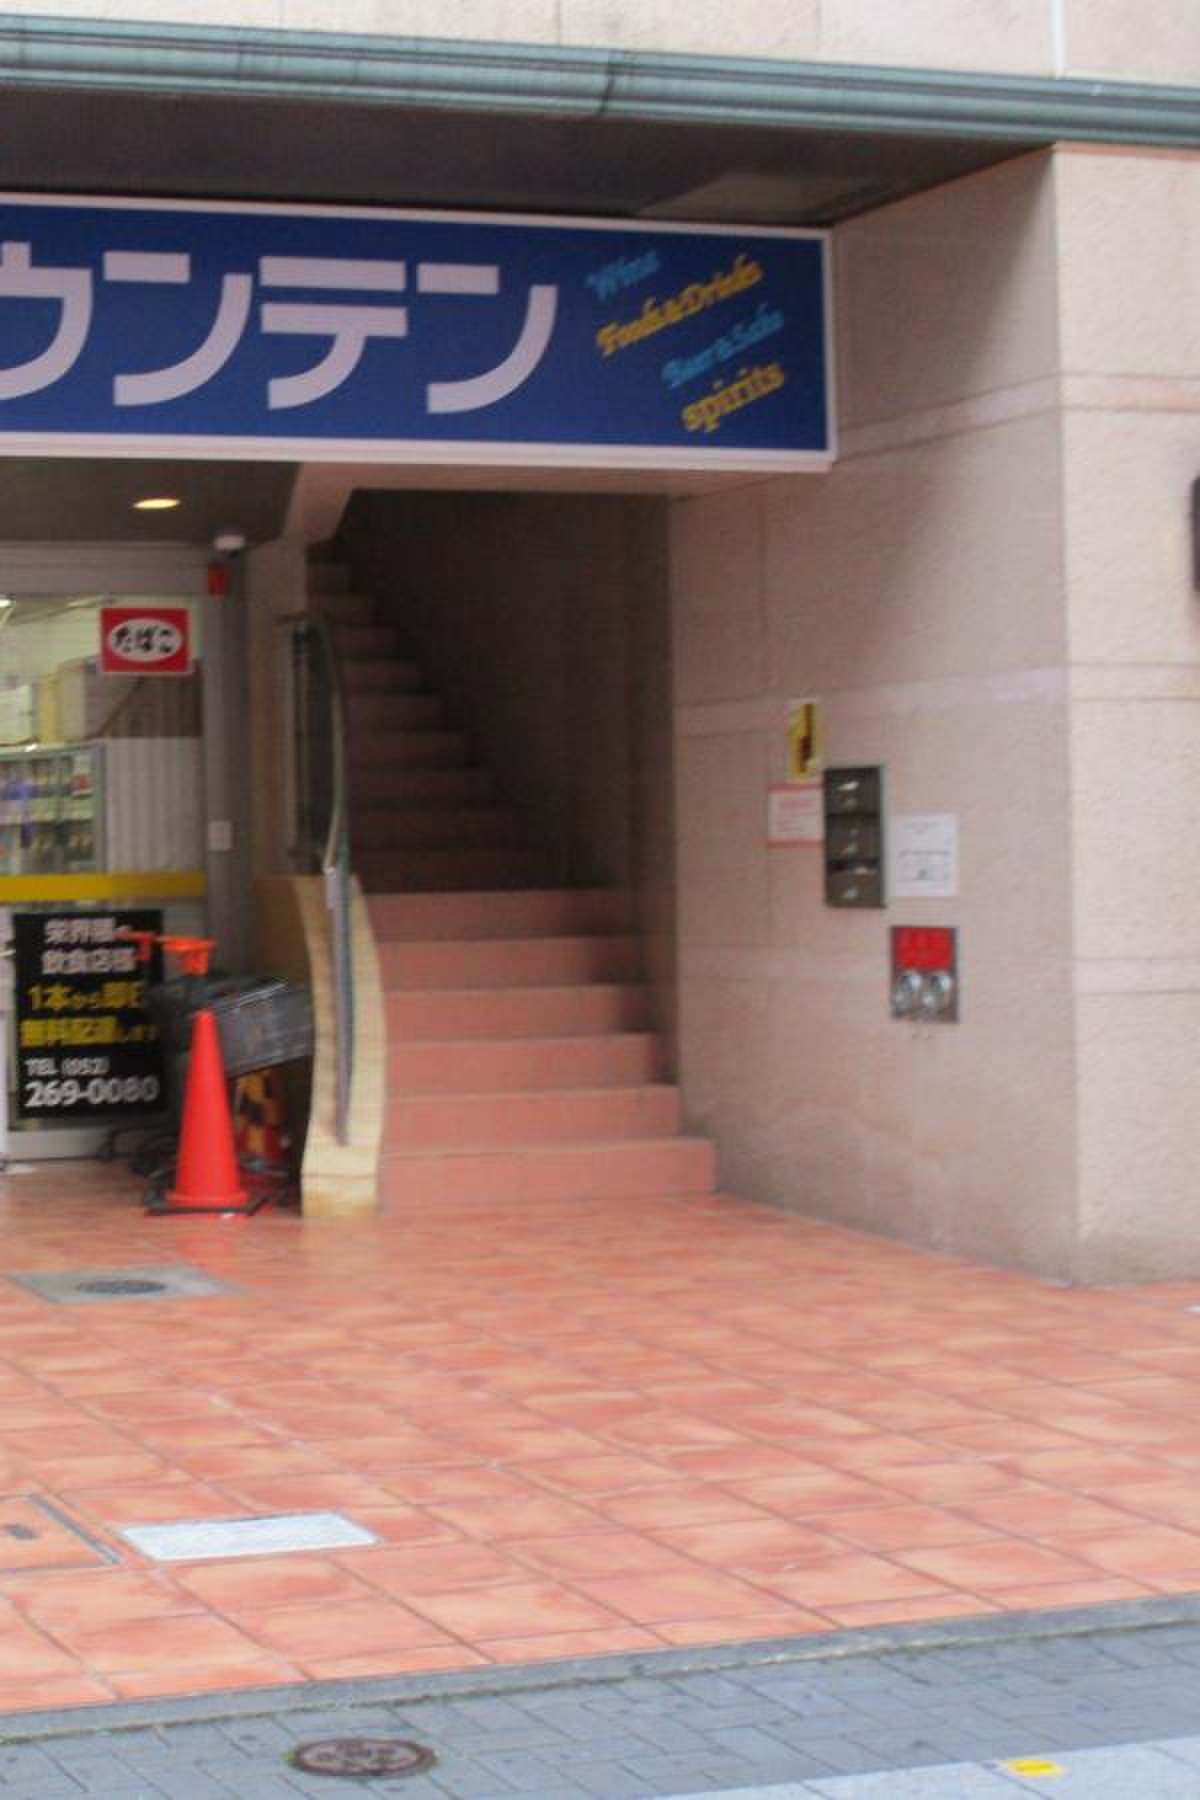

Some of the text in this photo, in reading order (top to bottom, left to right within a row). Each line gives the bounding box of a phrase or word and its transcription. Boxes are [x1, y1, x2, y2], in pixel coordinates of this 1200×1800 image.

[681, 363, 785, 432] spirits
[113, 623, 175, 654] たばこ
[25, 1058, 57, 1077] TEL
[25, 1077, 160, 1108] 269-0080
